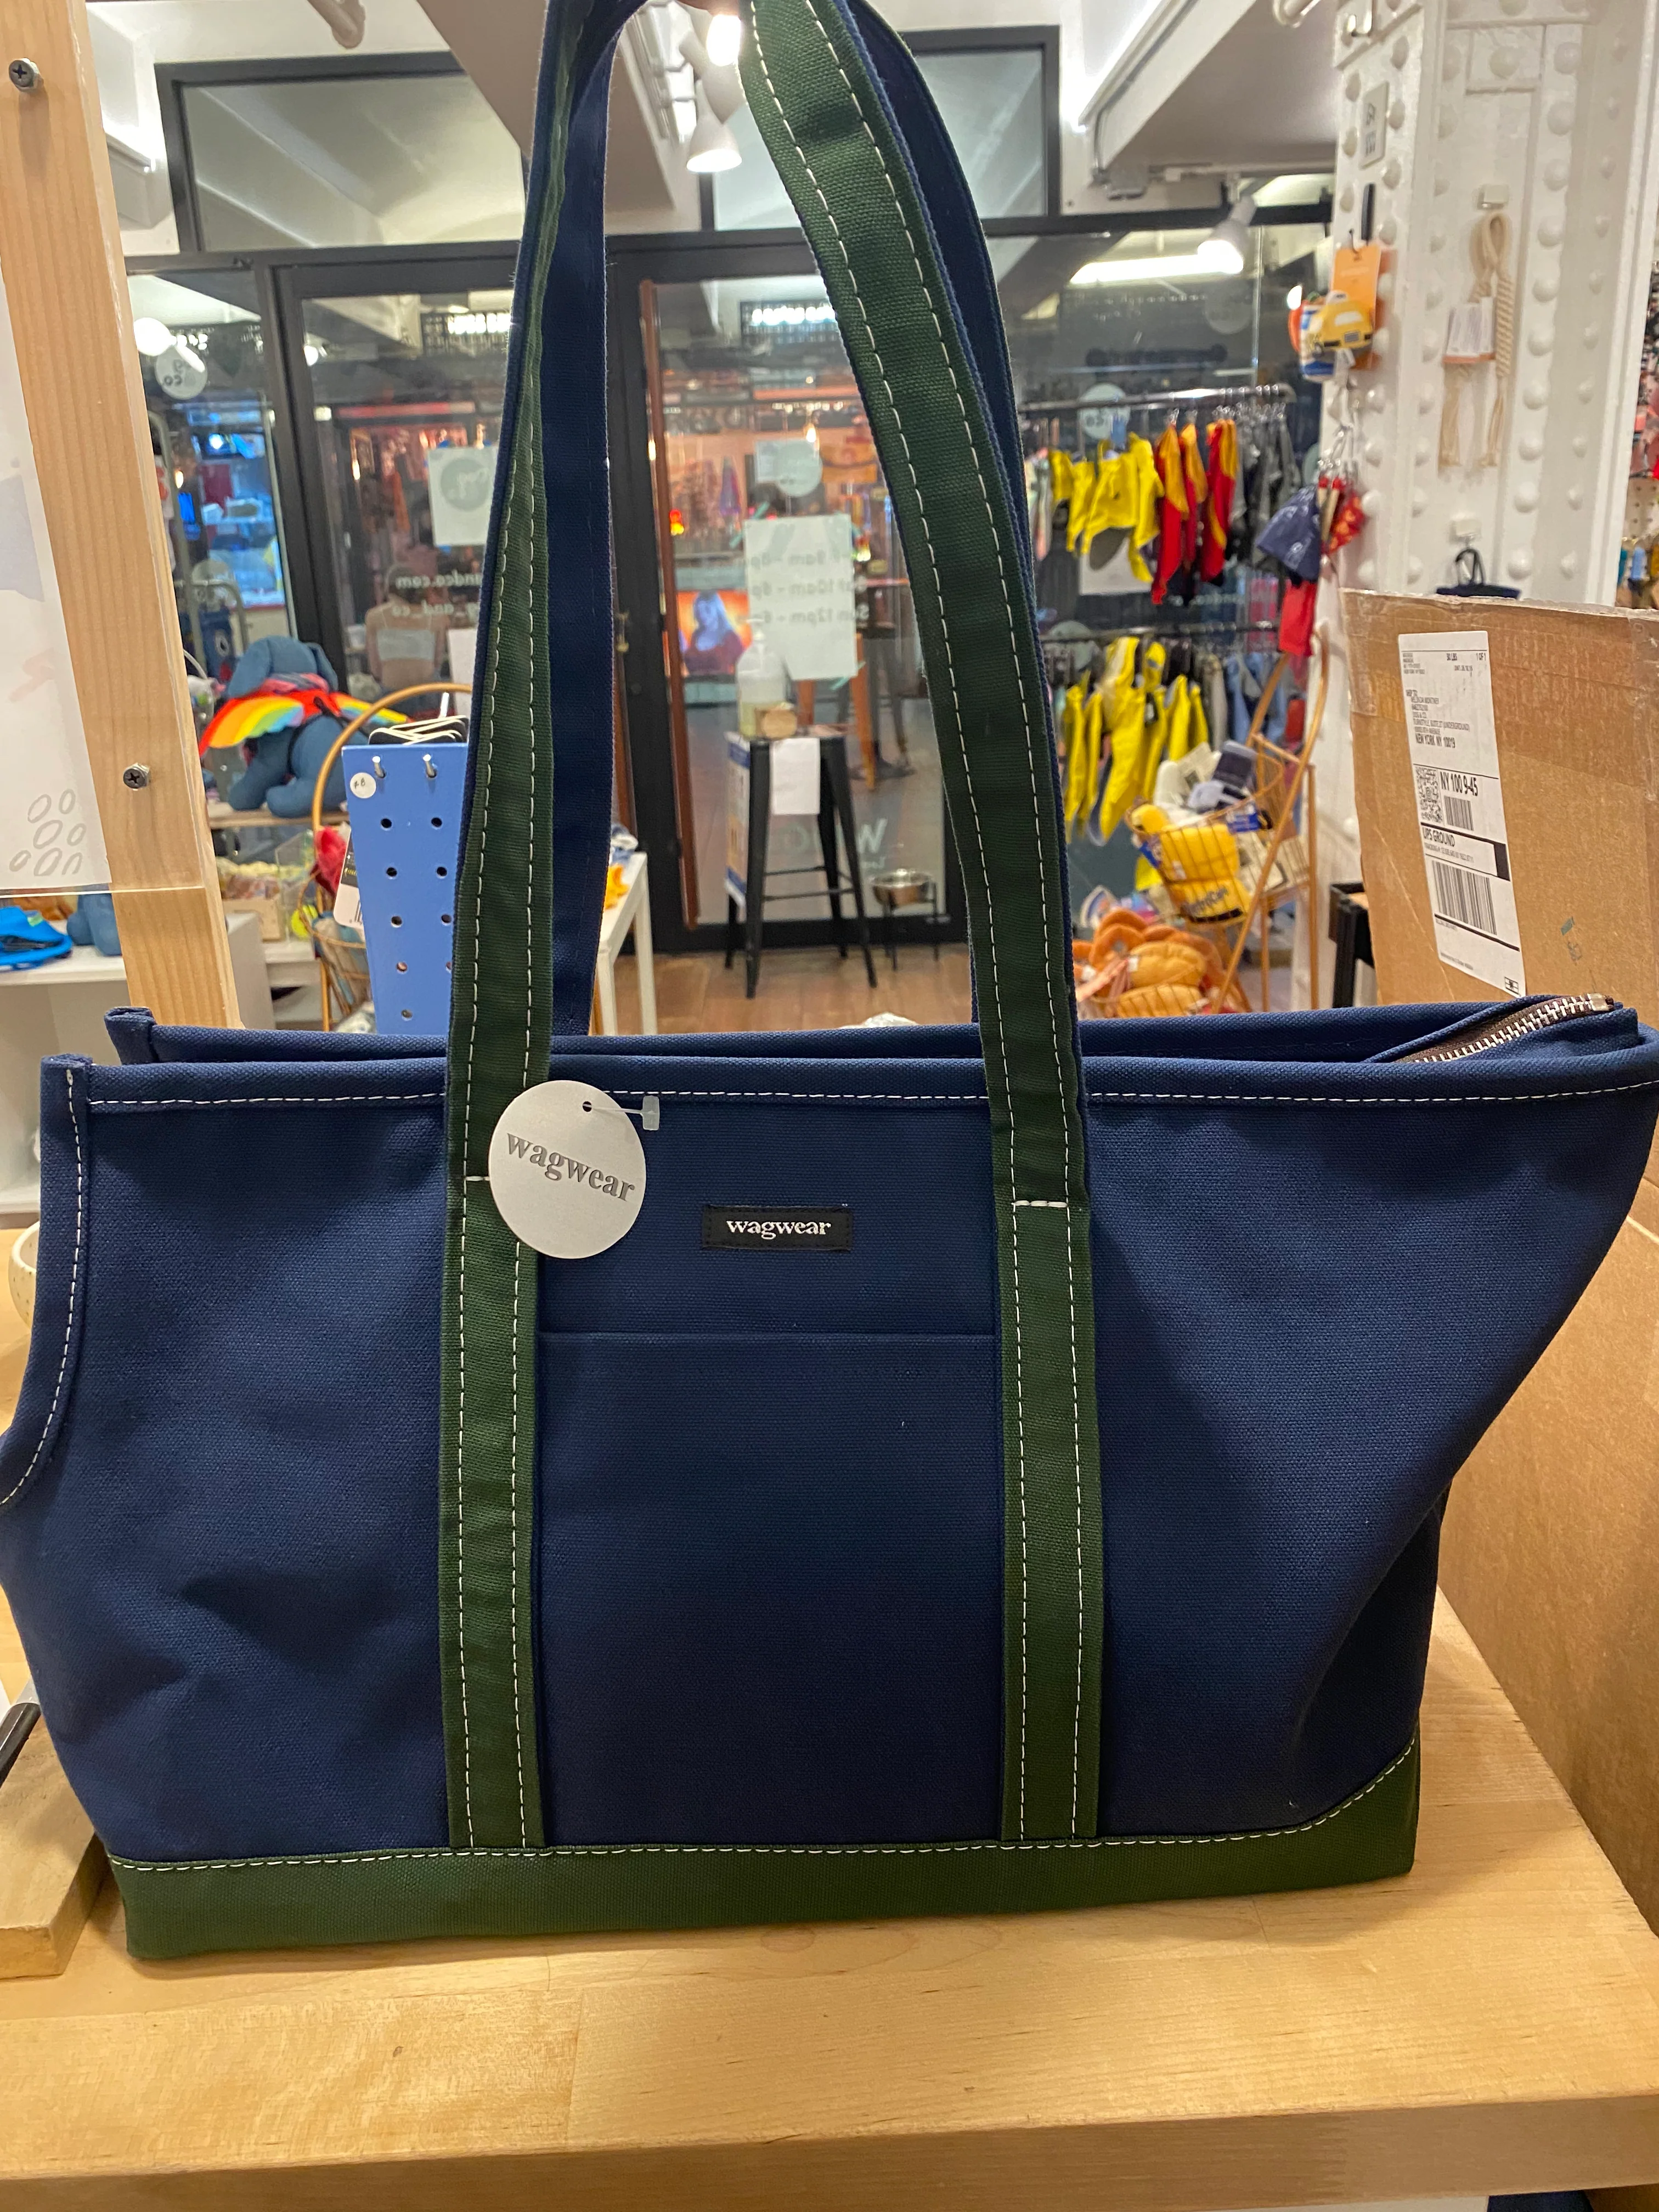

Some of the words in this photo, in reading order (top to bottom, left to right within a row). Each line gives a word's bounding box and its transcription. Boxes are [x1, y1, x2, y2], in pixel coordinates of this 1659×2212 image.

[1440, 771, 1450, 791] NY
[1422, 827, 1432, 841] UPS
[1432, 830, 1455, 847] GROUND
[507, 1132, 635, 1201] wagwear
[726, 1219, 831, 1239] wagwear
